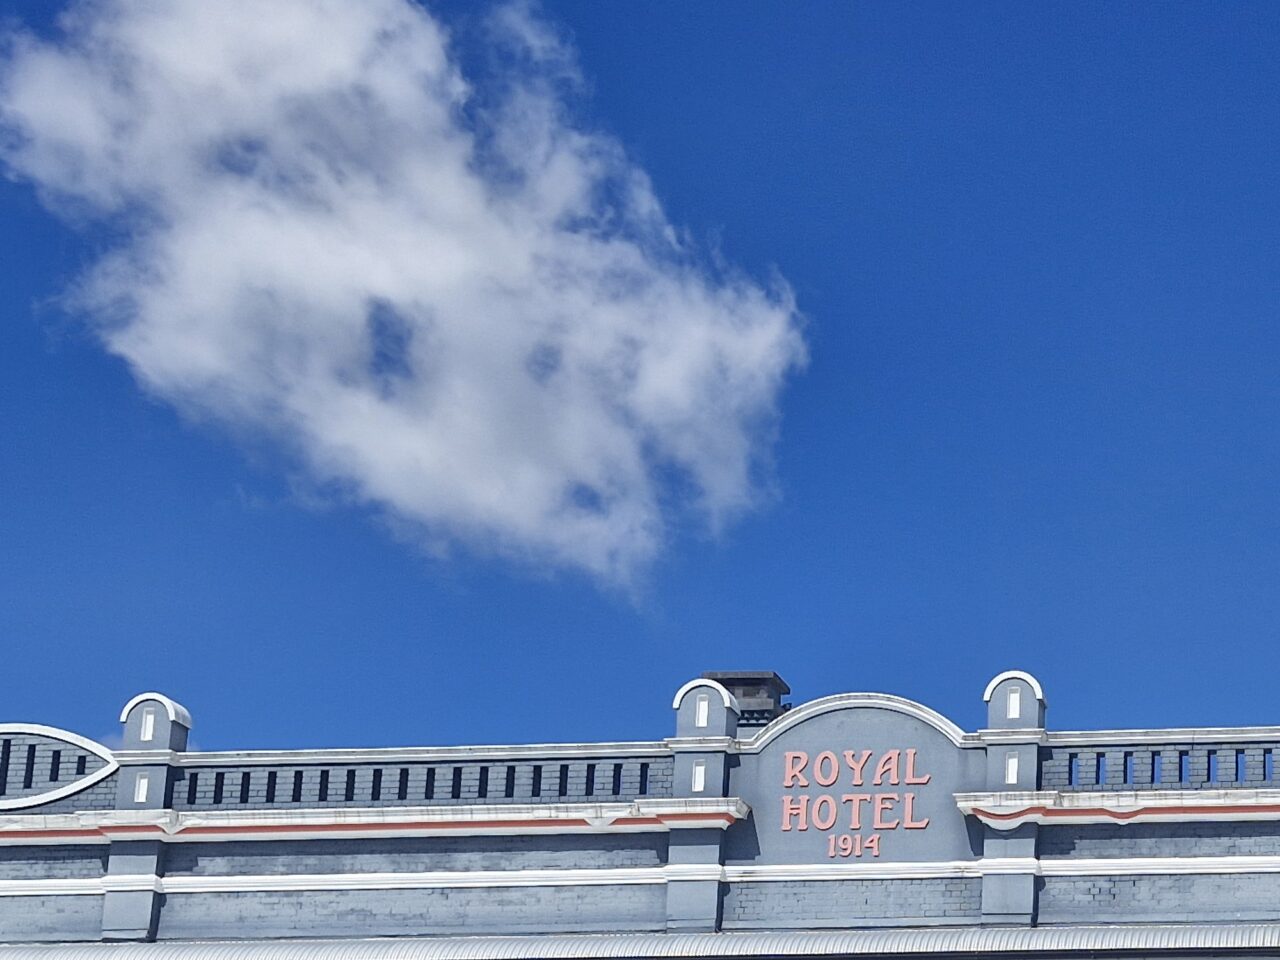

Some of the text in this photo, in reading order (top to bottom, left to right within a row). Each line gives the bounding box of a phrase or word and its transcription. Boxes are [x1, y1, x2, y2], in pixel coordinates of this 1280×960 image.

[783, 748, 931, 788] ROYAL
[781, 793, 930, 831] HOTEL
[828, 834, 881, 858] 1914
